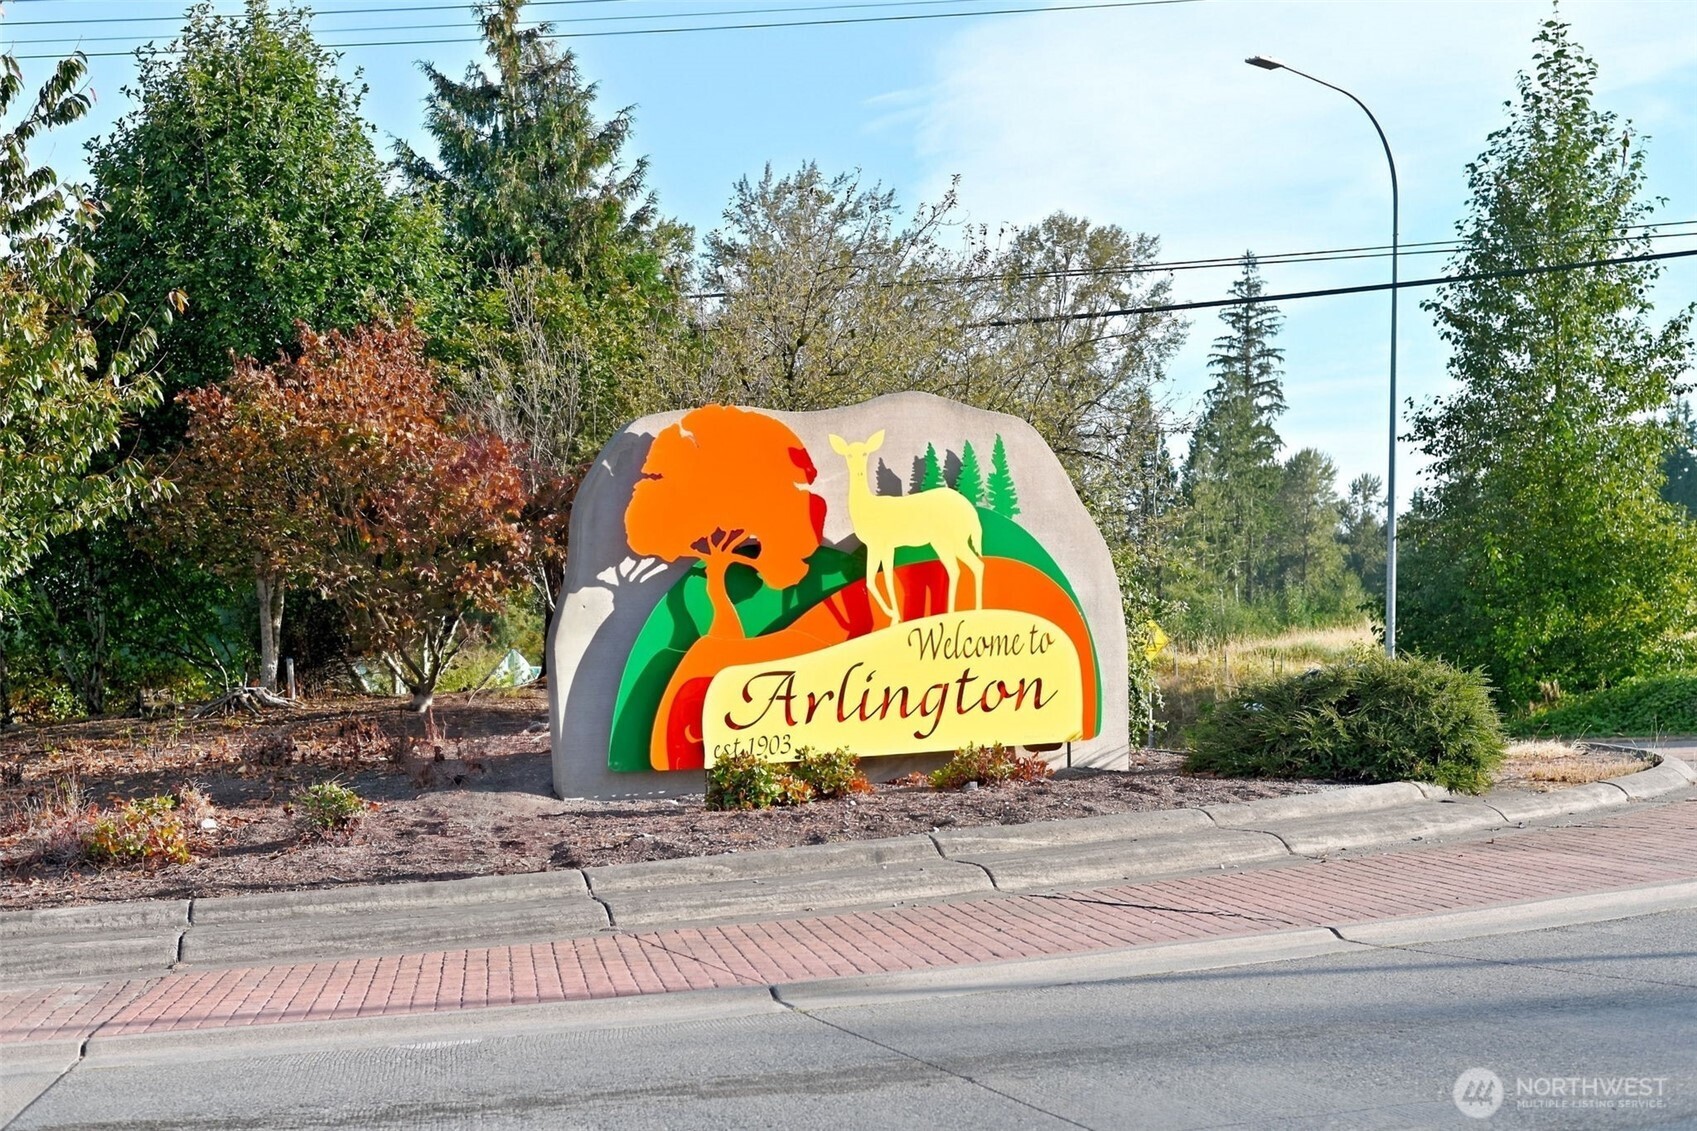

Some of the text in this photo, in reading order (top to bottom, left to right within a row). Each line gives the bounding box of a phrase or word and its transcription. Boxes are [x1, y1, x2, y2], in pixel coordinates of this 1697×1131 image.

[907, 619, 1056, 661] Welcome to
[724, 662, 1058, 740] Arlington
[748, 733, 792, 757] 1903
